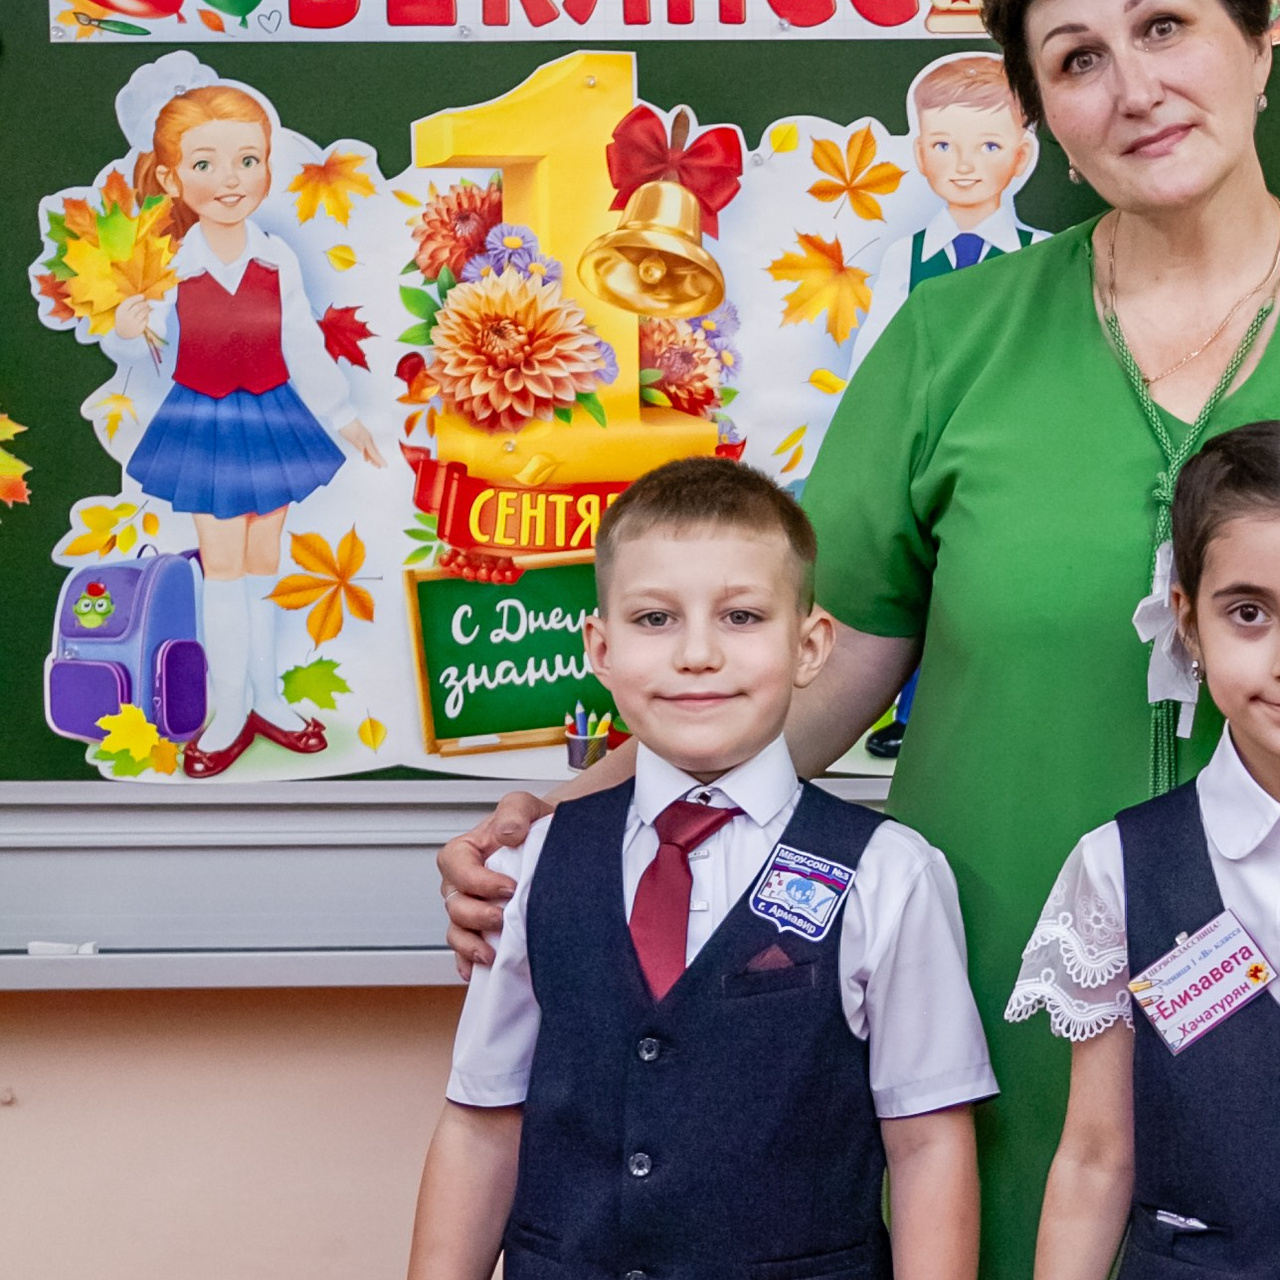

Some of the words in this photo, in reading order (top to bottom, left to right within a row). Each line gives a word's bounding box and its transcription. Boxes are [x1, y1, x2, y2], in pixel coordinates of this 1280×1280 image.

[469, 487, 619, 548] СЕНТЯ
[451, 604, 480, 645] С
[439, 651, 594, 719] знани
[778, 848, 830, 874] МБОУ-СОШ
[768, 905, 817, 934] Армавир
[1155, 945, 1254, 1021] Елизавета
[1178, 981, 1252, 1038] Хачатурян
